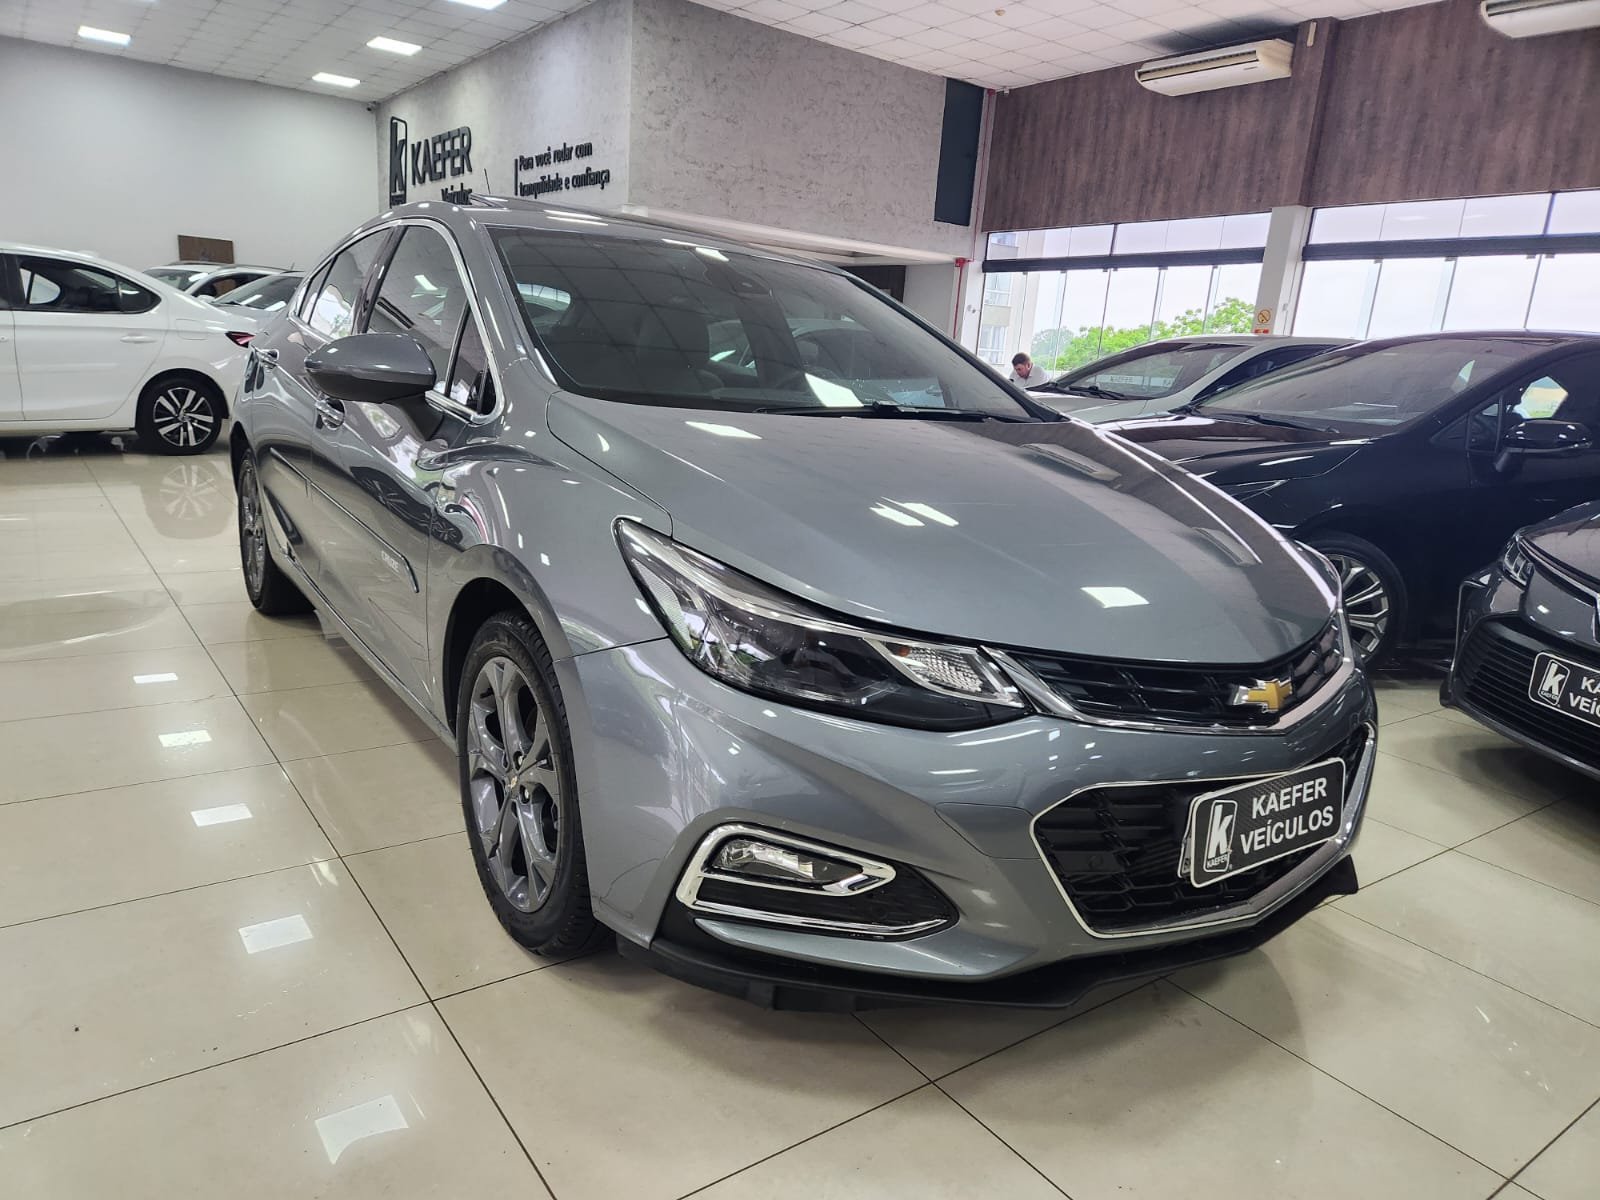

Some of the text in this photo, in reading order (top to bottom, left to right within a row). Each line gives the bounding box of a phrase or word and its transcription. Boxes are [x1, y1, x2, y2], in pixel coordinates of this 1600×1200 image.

[411, 126, 472, 186] KAEFER
[519, 142, 592, 171] Para você rodar com
[565, 177, 570, 190] e
[571, 167, 610, 190] confiança
[1252, 778, 1328, 819] KAEFER
[1240, 805, 1334, 854] VEÍCULOS
